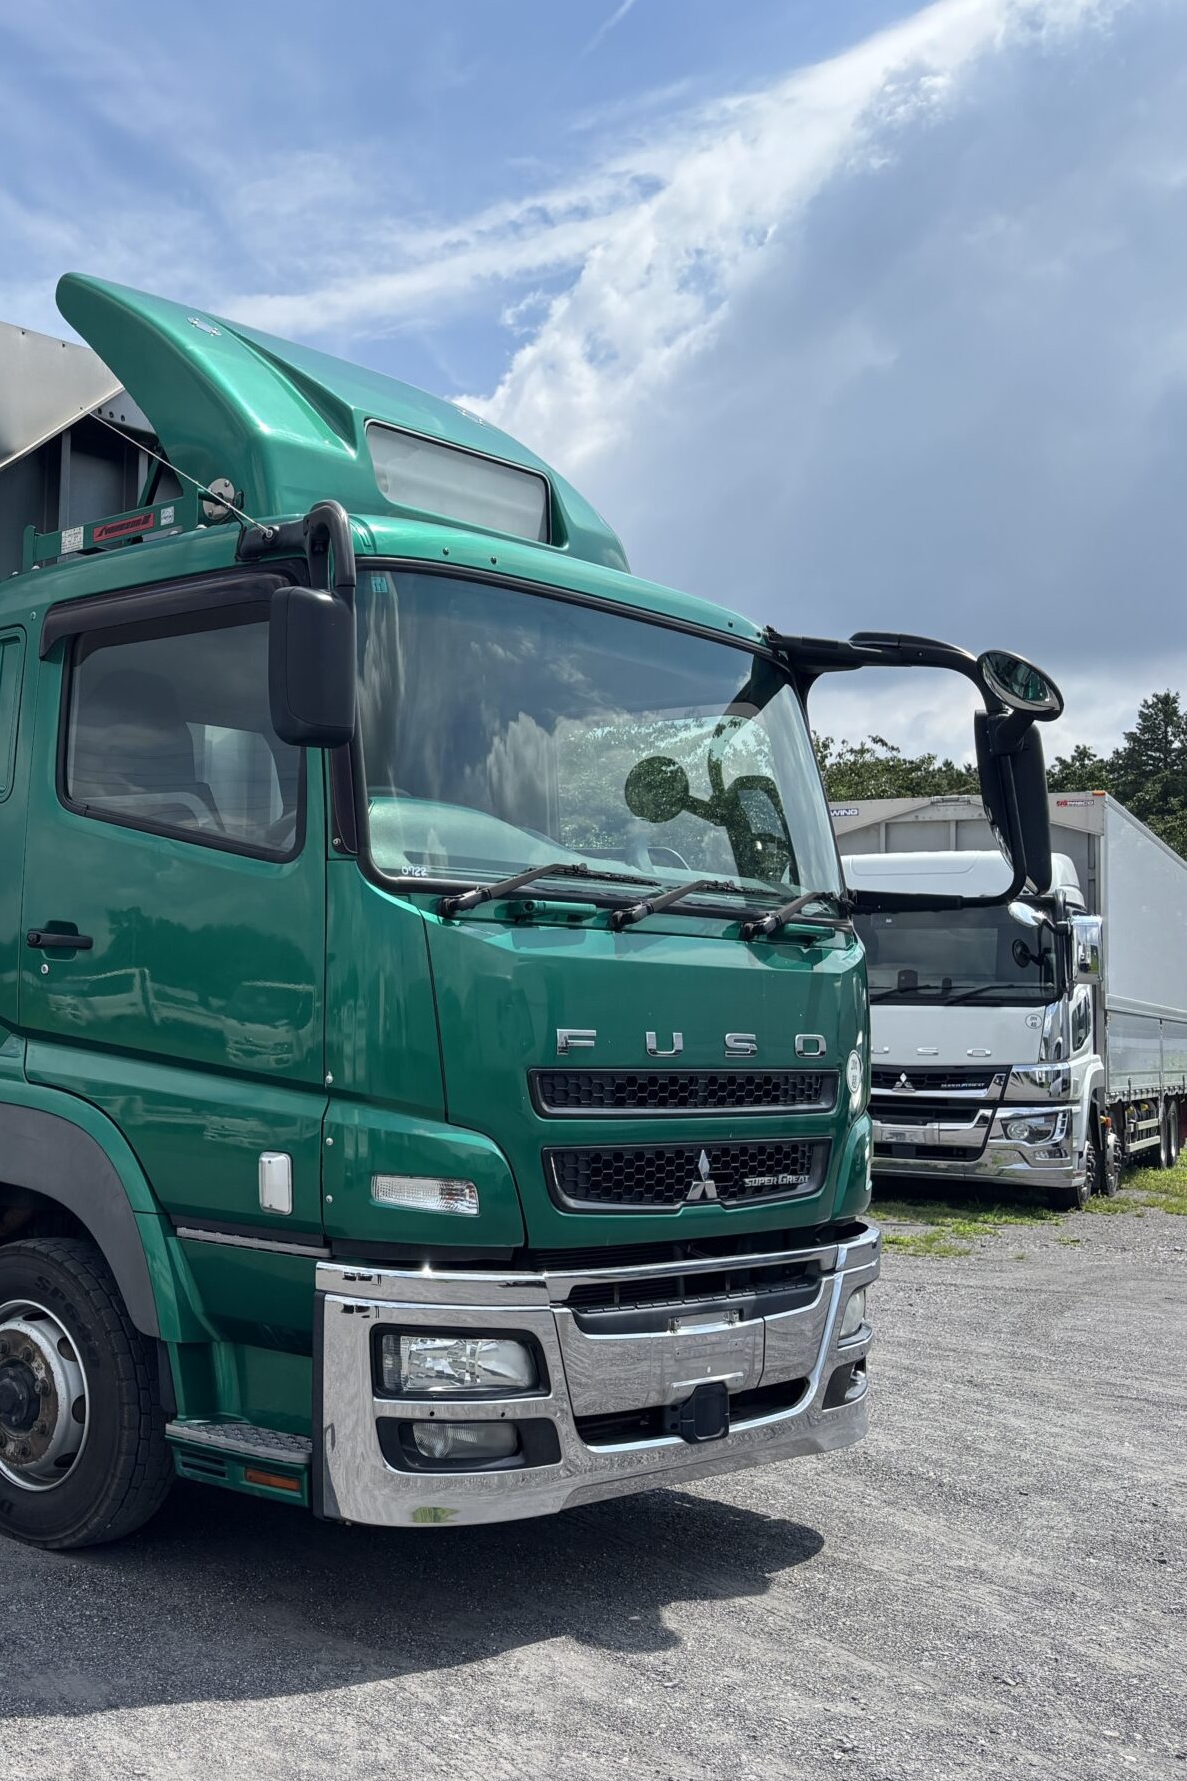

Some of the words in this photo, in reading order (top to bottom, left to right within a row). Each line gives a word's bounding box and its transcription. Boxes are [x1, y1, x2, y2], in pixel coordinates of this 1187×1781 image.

[402, 865, 428, 877] 0722
[556, 1028, 827, 1058] FUSO
[870, 1046, 992, 1057] USO
[743, 1176, 777, 1187] SUPER
[778, 1173, 810, 1185] GREAT
